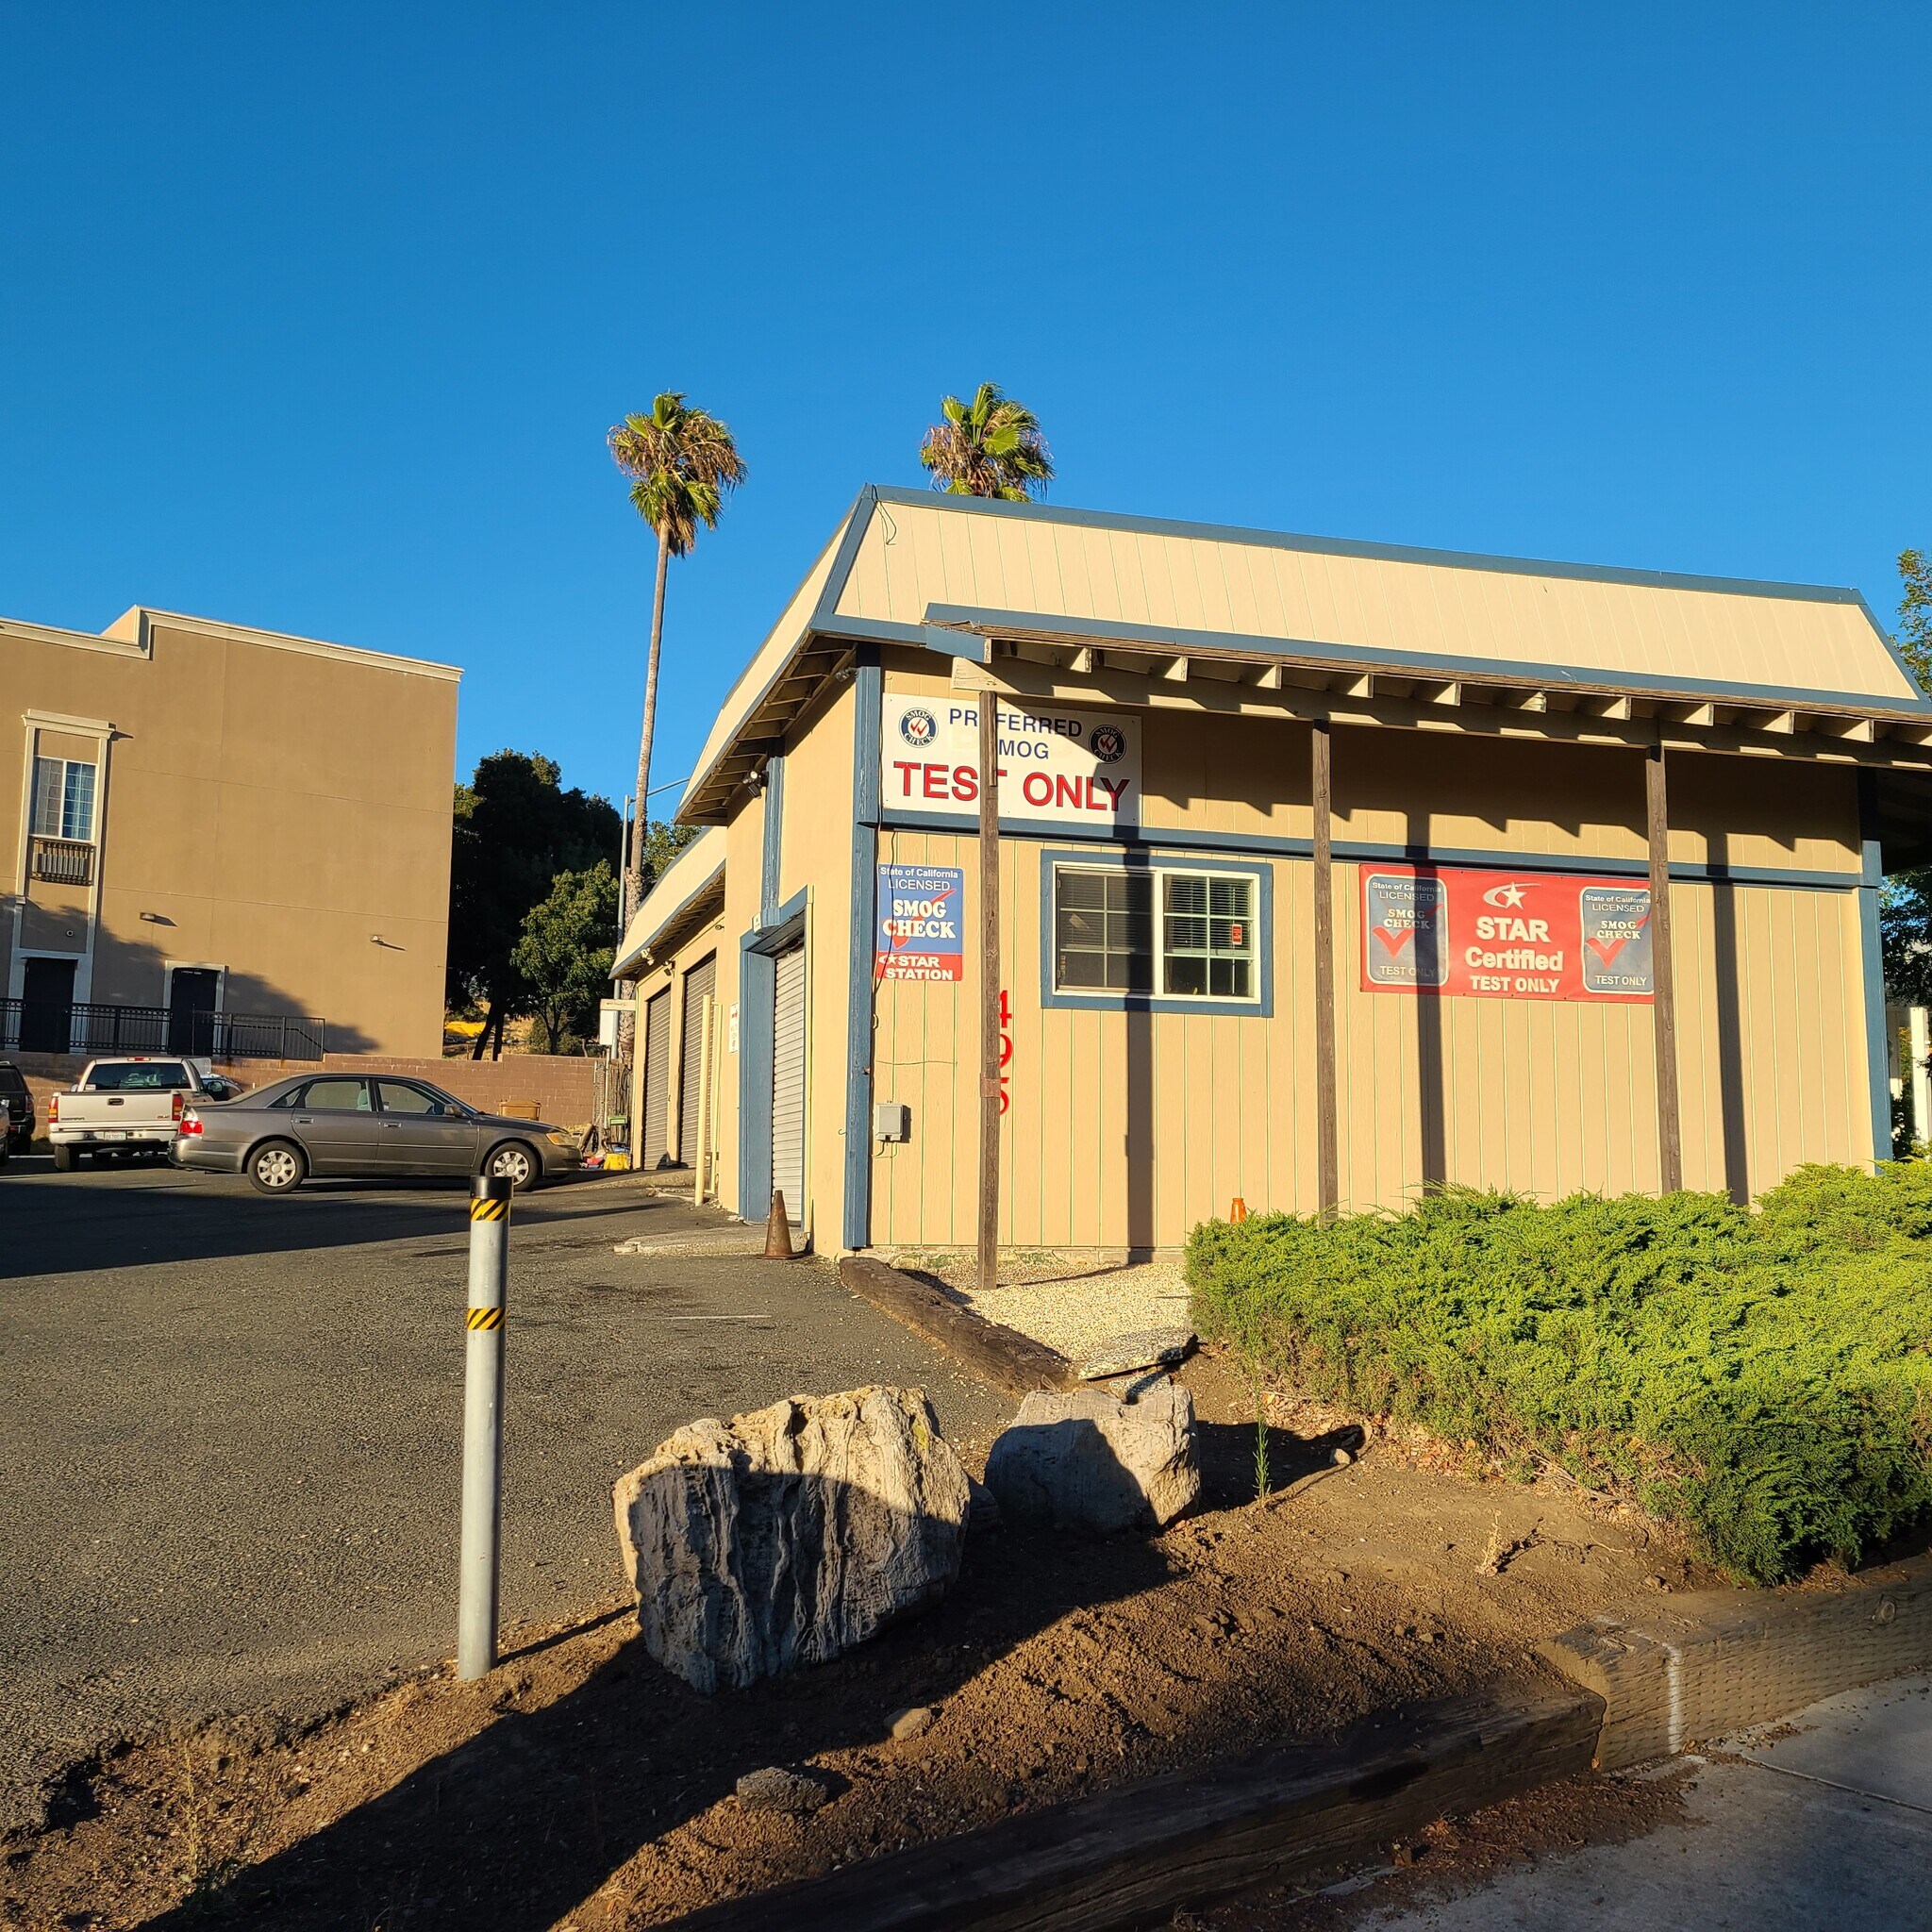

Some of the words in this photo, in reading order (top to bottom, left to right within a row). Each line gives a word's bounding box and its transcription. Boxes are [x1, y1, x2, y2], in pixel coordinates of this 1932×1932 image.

[906, 709, 931, 721] SMOG
[949, 708, 1082, 738] PRFERRED
[905, 732, 934, 745] CHECK
[1095, 727, 1120, 739] SMOG
[997, 739, 1049, 759] MOG
[1023, 772, 1131, 812] ONLY
[880, 867, 903, 876] State
[906, 868, 915, 876] of
[916, 868, 958, 878] California
[888, 879, 951, 891] LICENSED
[1372, 882, 1392, 891] State
[1404, 884, 1441, 892] California
[1379, 891, 1435, 902] LICENSED
[1585, 894, 1605, 903] State
[892, 899, 947, 918] SMOG
[1388, 908, 1425, 919] SMOG
[1591, 903, 1644, 913] LICENSED
[882, 919, 957, 939] CHECK
[1383, 919, 1431, 929] CHECK
[1476, 915, 1552, 943] STAR
[1600, 920, 1638, 930] SMOG
[1596, 930, 1641, 940] CHECK
[898, 955, 941, 968] STAR
[1465, 946, 1564, 972] Certified
[885, 967, 954, 980] STATION
[1379, 965, 1407, 975] TEST
[1408, 967, 1436, 977] ONLY
[1470, 974, 1511, 991] TEST
[1514, 977, 1560, 993] ONLY
[1595, 974, 1621, 985] TEST
[1622, 976, 1647, 986] ONLY
